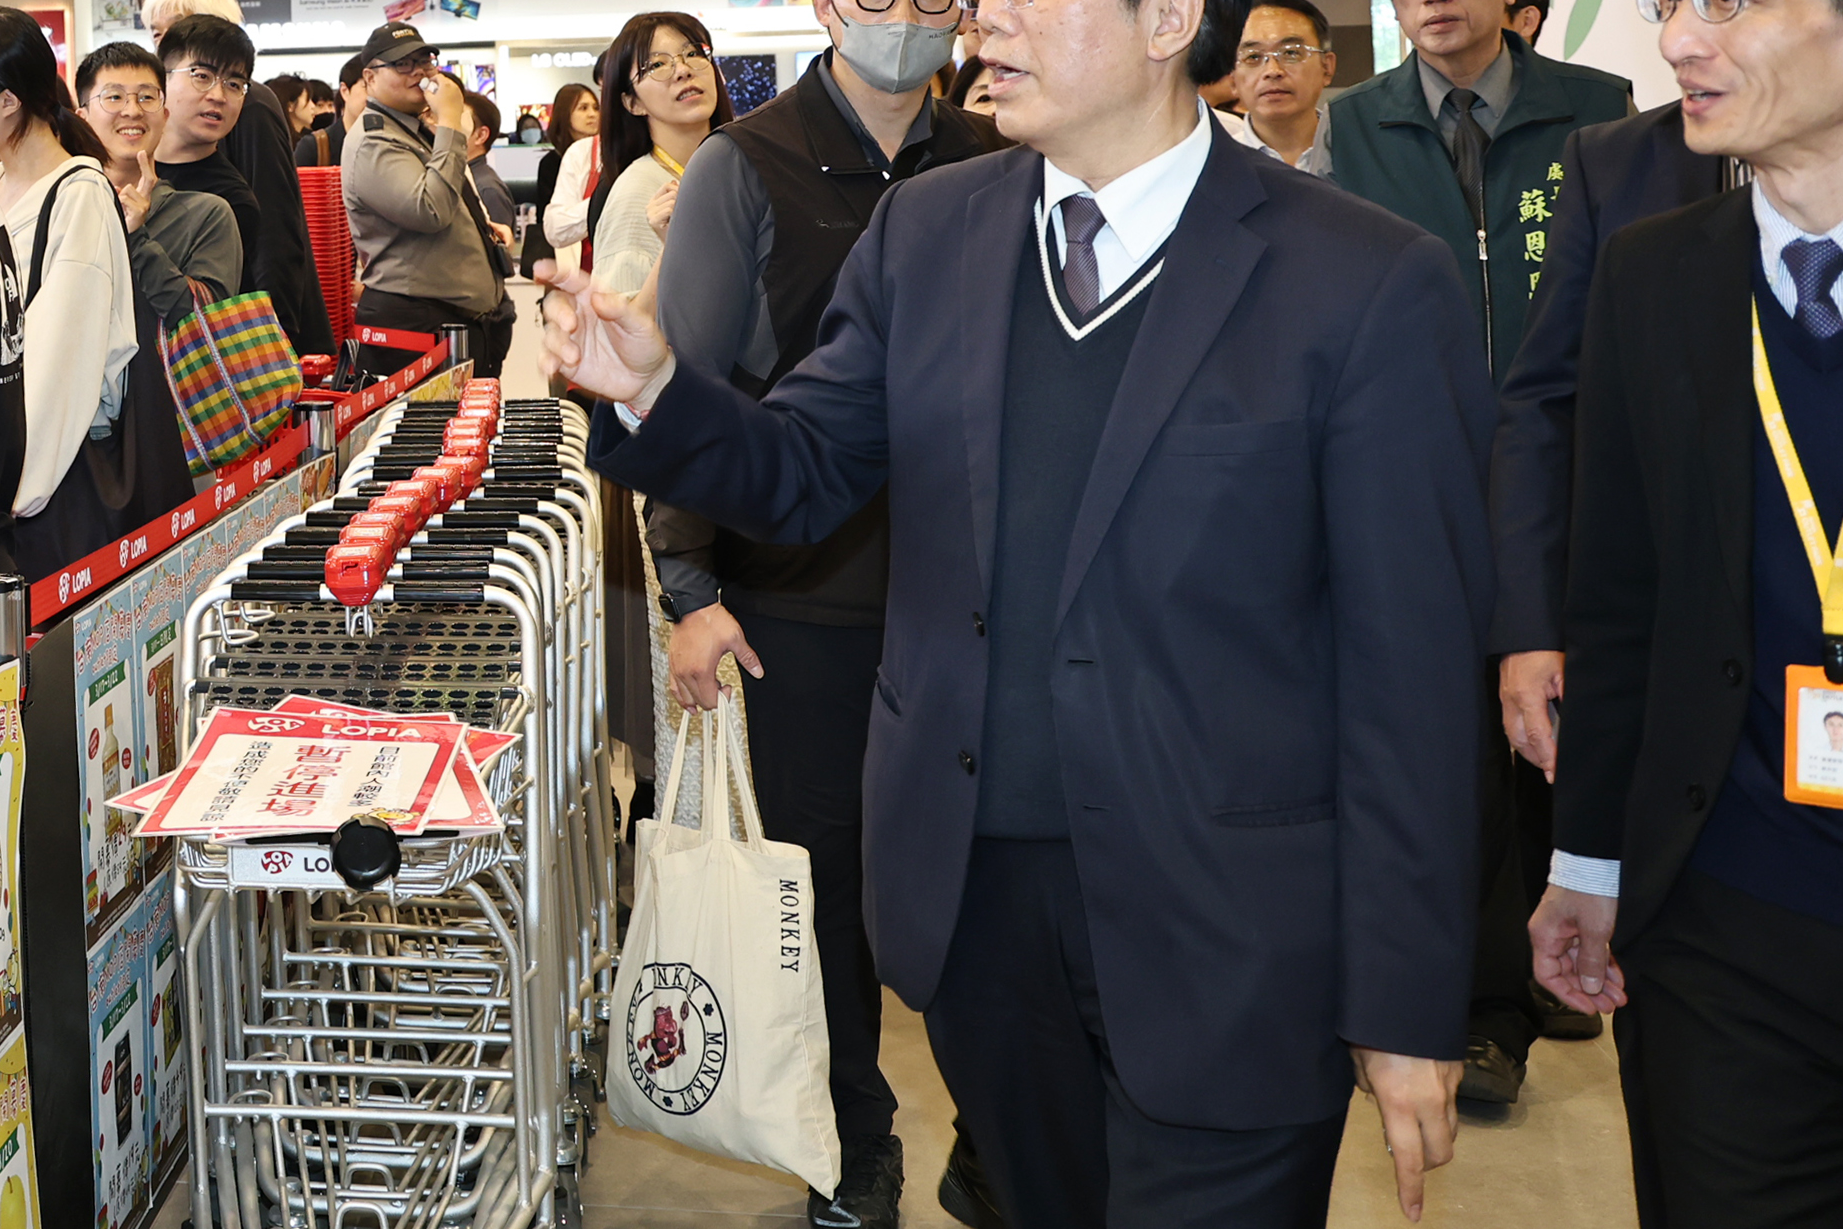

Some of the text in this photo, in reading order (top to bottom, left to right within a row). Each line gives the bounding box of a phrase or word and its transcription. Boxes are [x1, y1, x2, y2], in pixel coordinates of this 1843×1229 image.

[130, 535, 148, 560] LOPIA
[72, 567, 93, 593] LOPIA
[321, 724, 422, 738] LOPIA
[257, 744, 351, 817] 暫停進場
[779, 878, 802, 974] MONKEY
